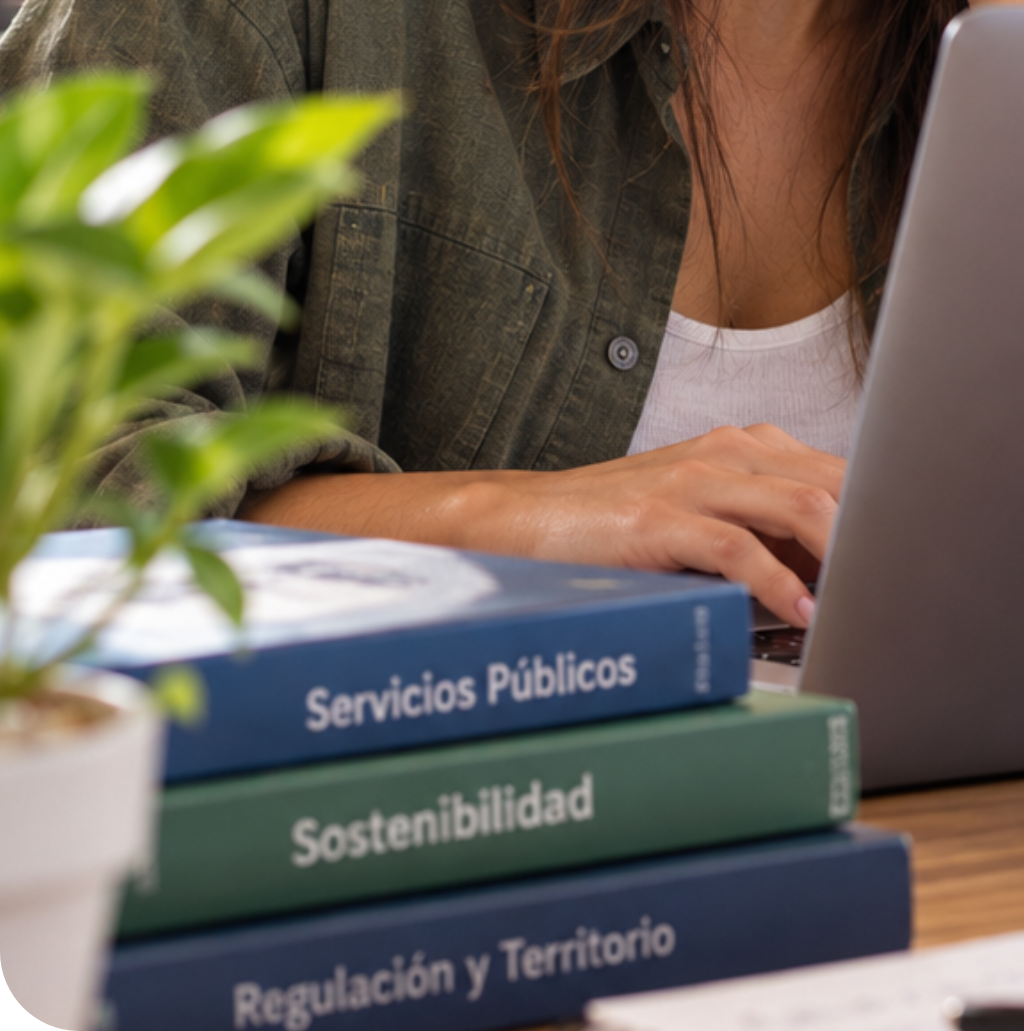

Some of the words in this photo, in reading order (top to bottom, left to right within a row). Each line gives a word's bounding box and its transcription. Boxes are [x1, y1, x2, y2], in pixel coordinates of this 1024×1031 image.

[305, 670, 477, 732] Servicios
[486, 652, 638, 705] Públicos
[291, 771, 595, 867] Sostenibilidad
[232, 950, 455, 1031] Regulación
[464, 954, 491, 1001] y
[499, 915, 676, 983] Territorio
